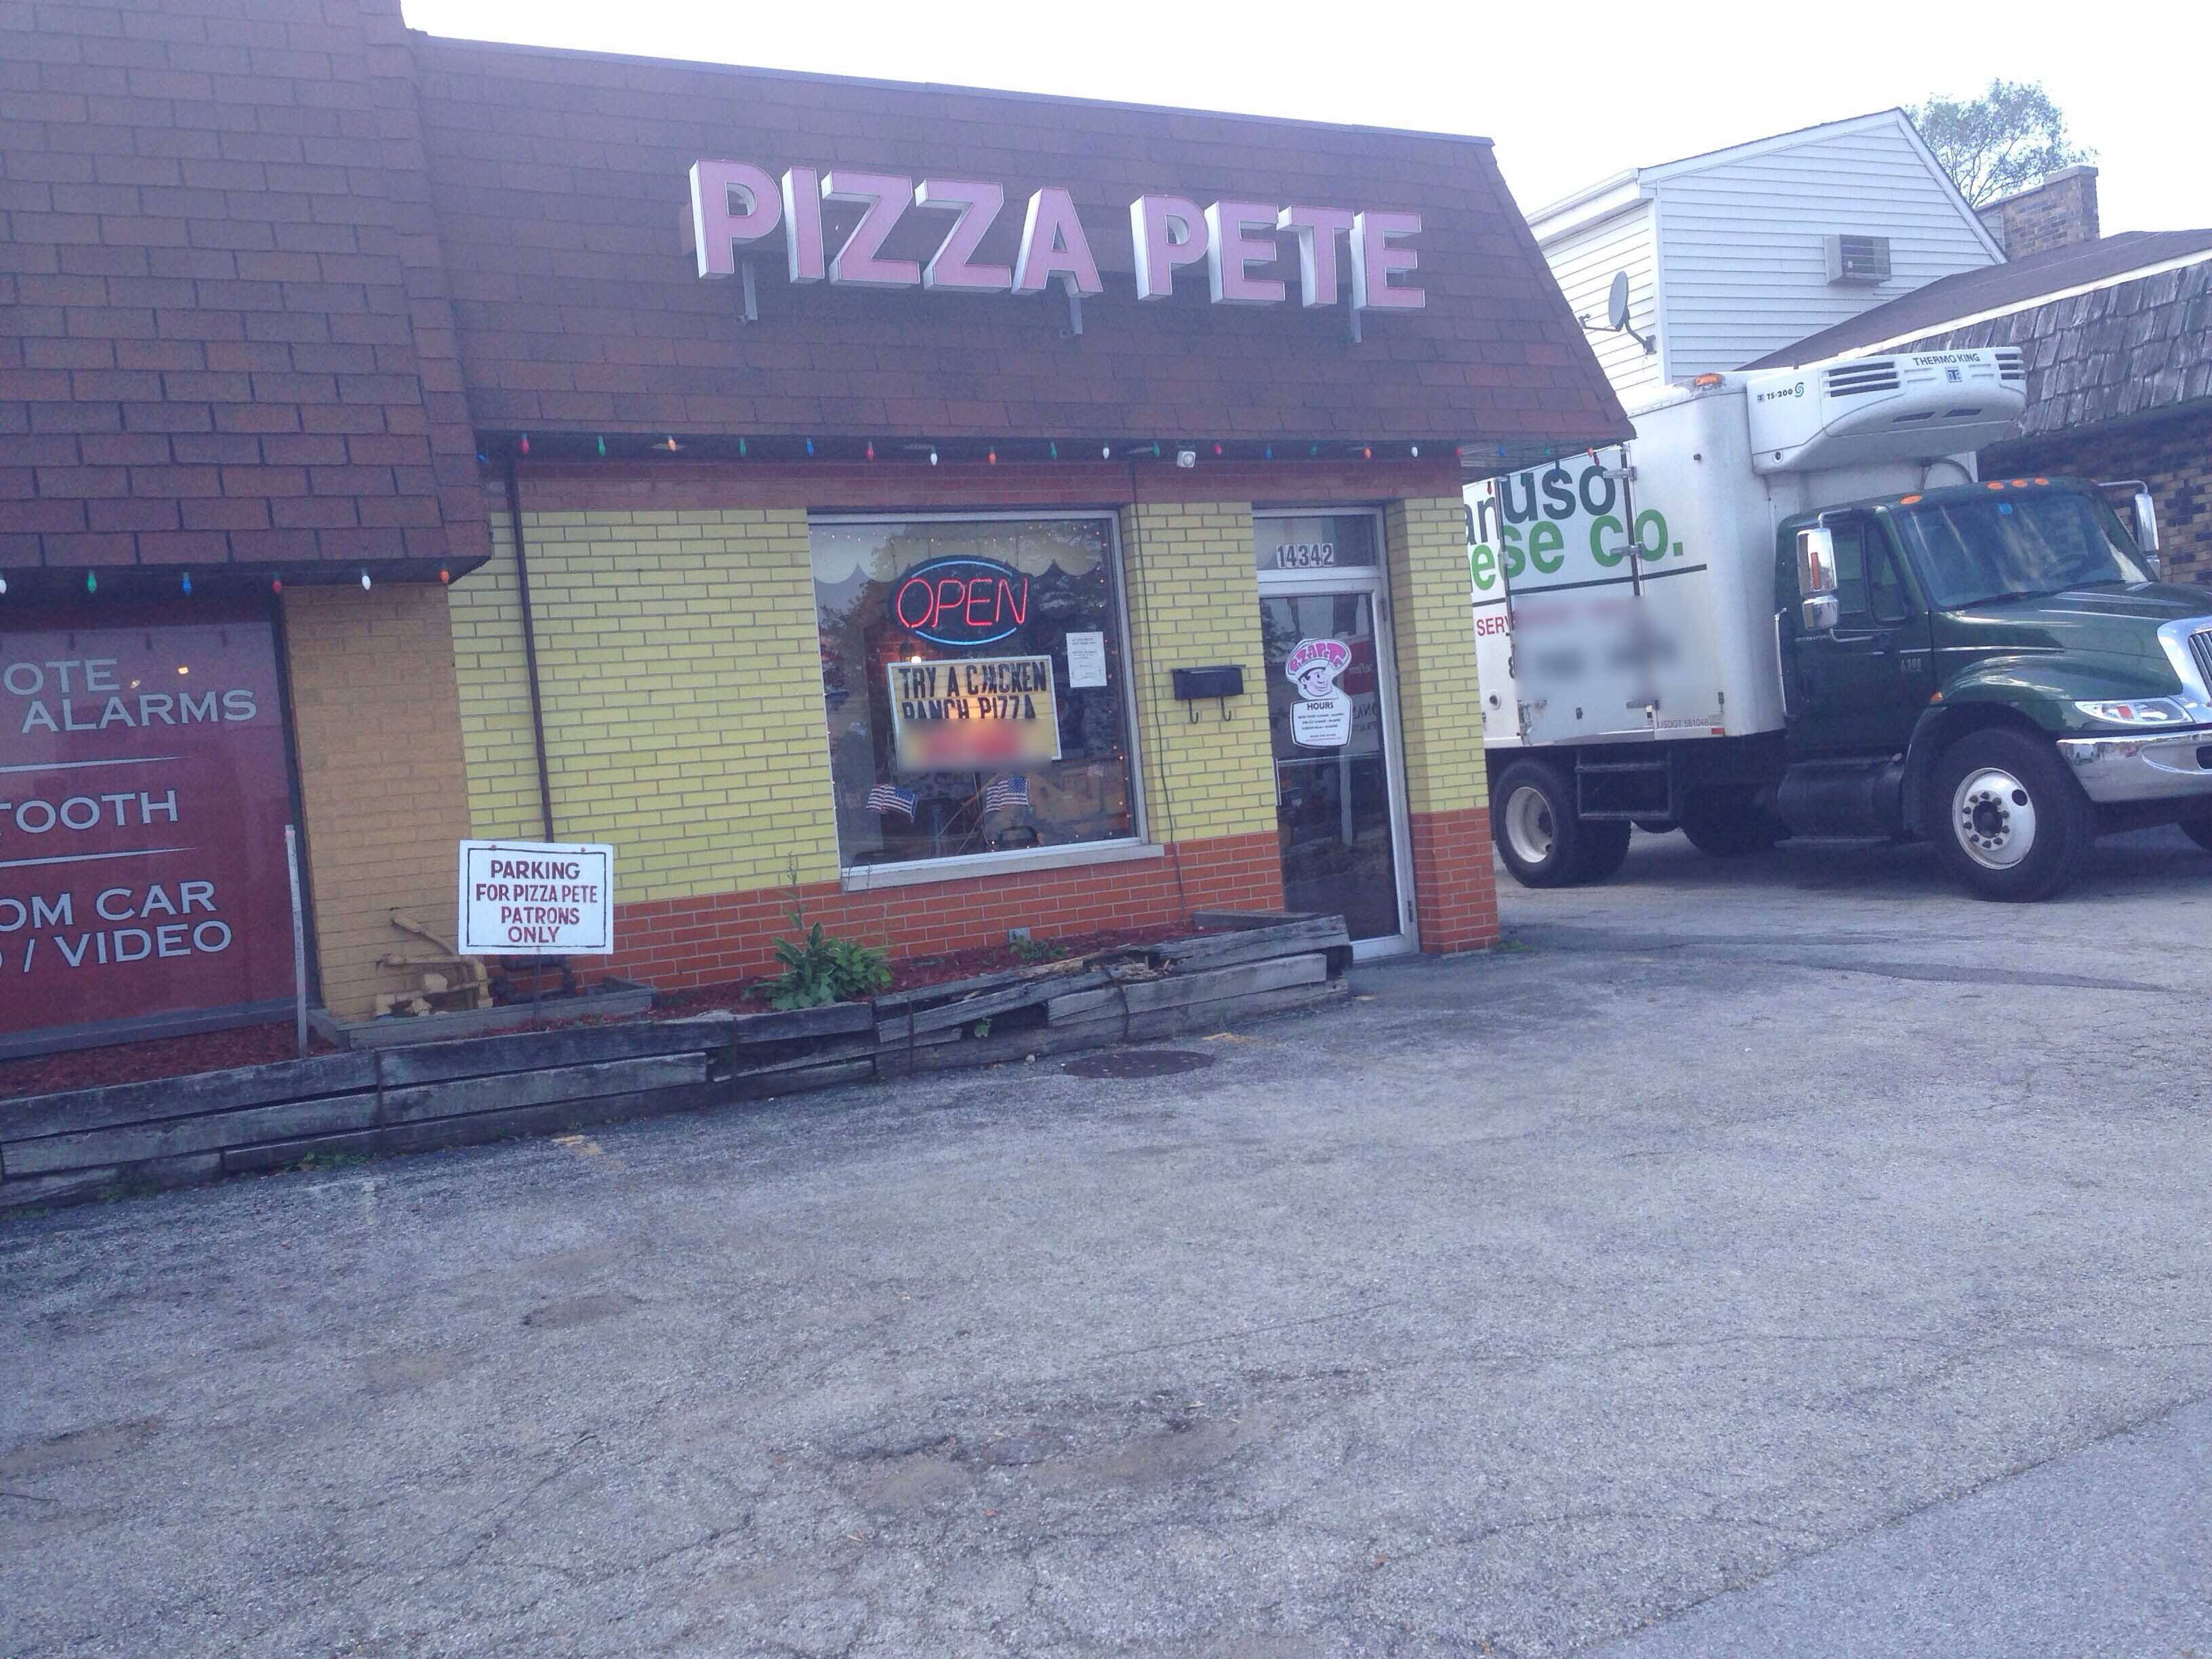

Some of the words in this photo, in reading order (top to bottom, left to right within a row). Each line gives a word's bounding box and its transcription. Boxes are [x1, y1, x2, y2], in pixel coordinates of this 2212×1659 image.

[689, 159, 1103, 295] PIZZA
[1129, 194, 1426, 311] PETE
[1912, 354, 1957, 366] THERMO
[1957, 353, 1981, 363] KING
[1767, 388, 1793, 400] TS-200
[1277, 544, 1334, 567] 14342
[896, 577, 1029, 629] OPEN
[3, 658, 121, 695] OTE
[899, 667, 937, 699] TRY
[947, 666, 960, 697] A
[21, 689, 257, 734] ALARMS
[977, 694, 1036, 719] PIZZA
[1307, 701, 1334, 711] HOURS
[490, 860, 581, 880] PARKING
[96, 880, 218, 921] CAR
[476, 883, 510, 901] FOR
[513, 884, 558, 903] PIZZA
[561, 884, 598, 903] PETE
[501, 905, 580, 925] PATRONS
[56, 920, 232, 968] VIDEO
[508, 926, 560, 943] ONLY
